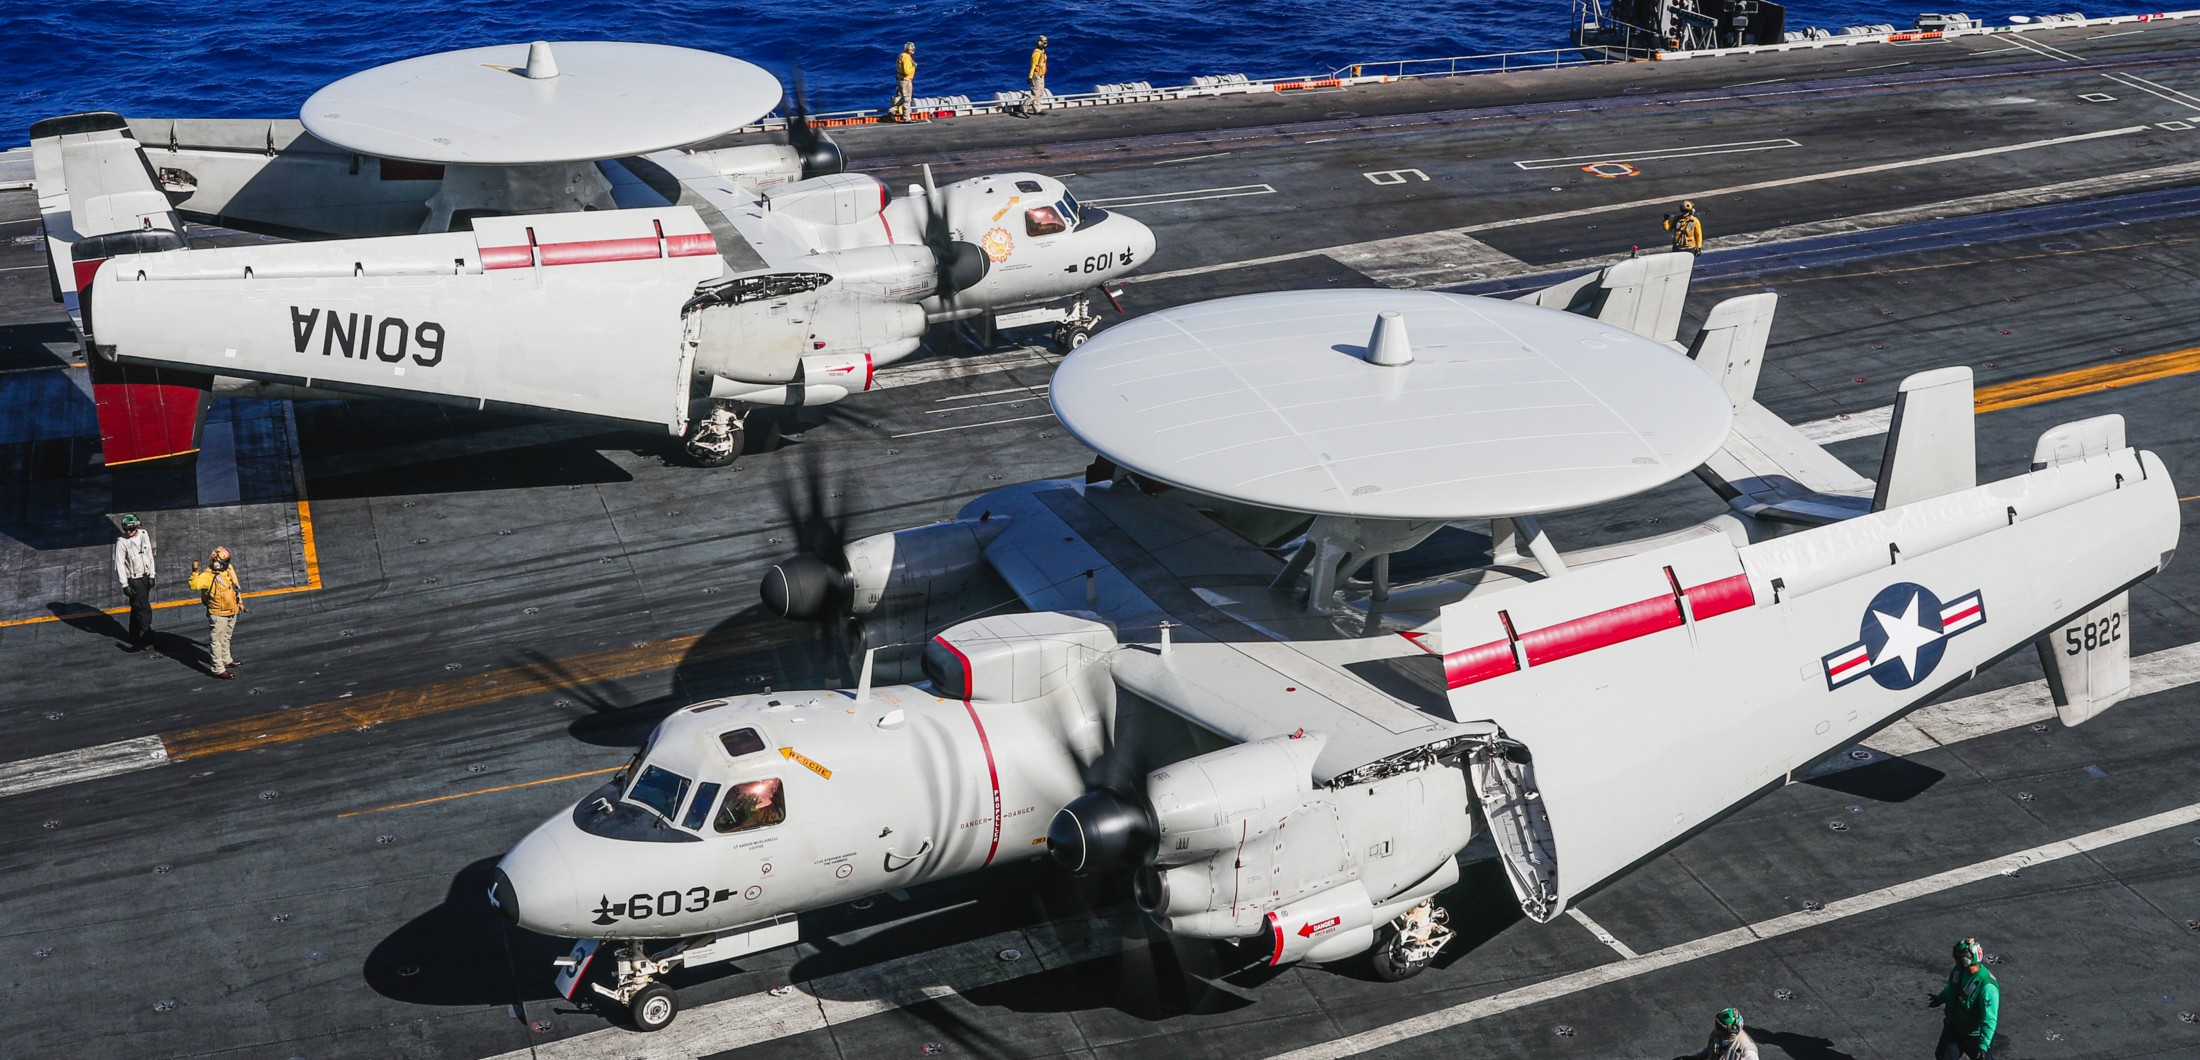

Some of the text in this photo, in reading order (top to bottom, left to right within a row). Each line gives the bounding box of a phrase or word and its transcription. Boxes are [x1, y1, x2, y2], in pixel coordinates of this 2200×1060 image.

[1083, 252, 1113, 273] 601
[2066, 612, 2120, 656] 5822
[789, 751, 828, 776] RESCUE
[1008, 807, 1035, 817] DANGER
[960, 818, 987, 829] DANGER
[628, 886, 710, 920] 603
[1313, 919, 1335, 931] DANGER
